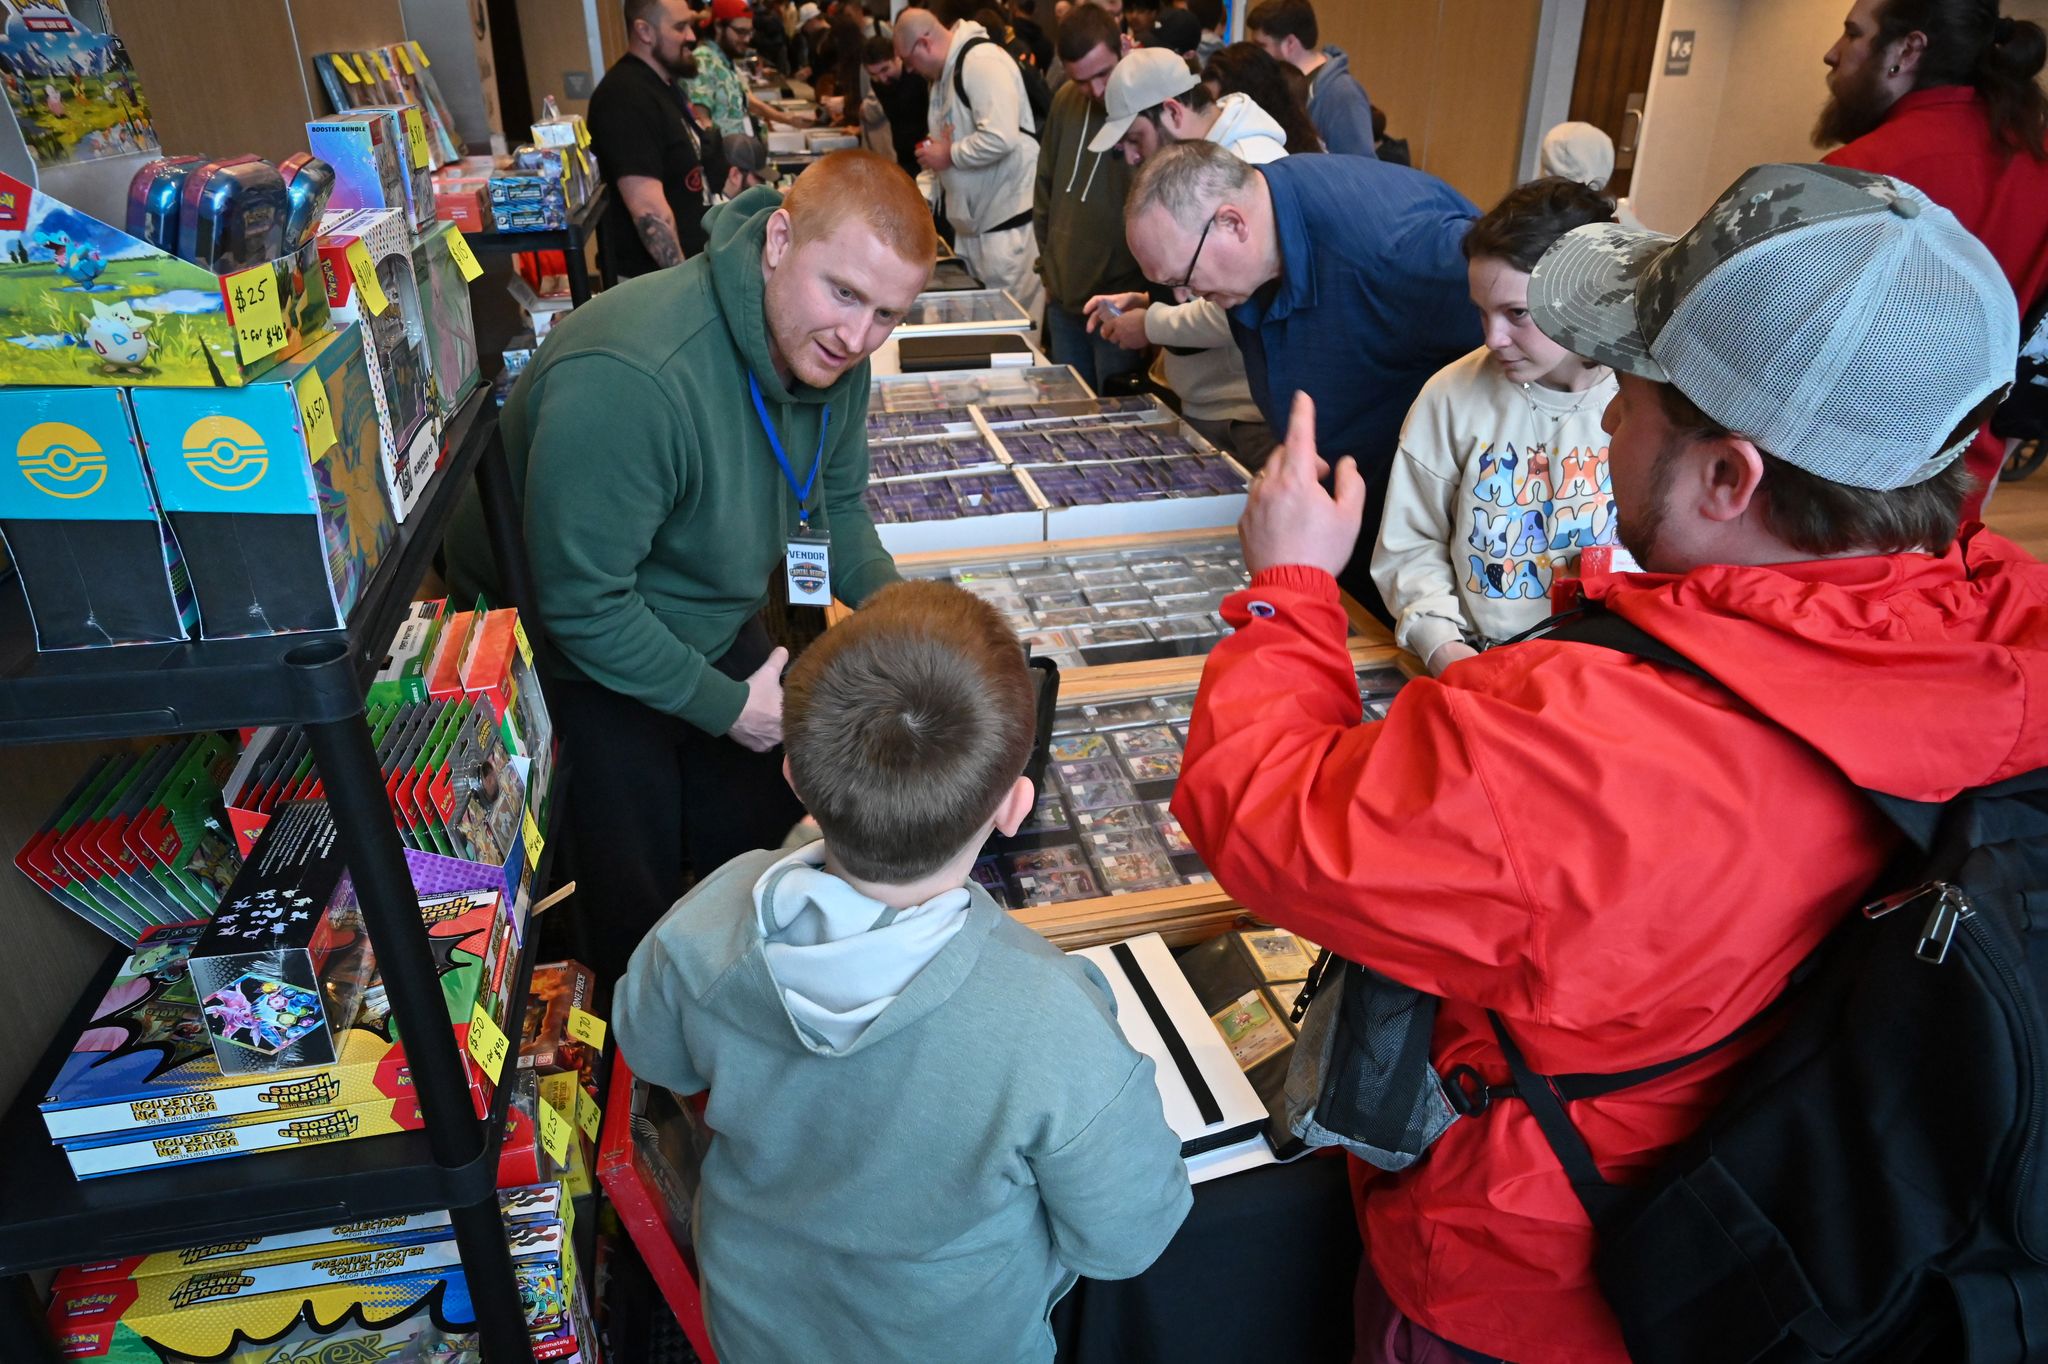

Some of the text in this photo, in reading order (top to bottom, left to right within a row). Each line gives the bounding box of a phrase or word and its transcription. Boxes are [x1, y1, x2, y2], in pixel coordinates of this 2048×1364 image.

[235, 278, 267, 313] $25
[241, 329, 248, 341] 2
[266, 324, 283, 348] $40
[305, 396, 325, 433] $150
[788, 550, 825, 561] VENDOR
[421, 896, 469, 914] HERO
[421, 901, 476, 919] ASCEN
[572, 972, 587, 1009] ONE PIECE
[469, 1016, 485, 1052] $50
[258, 1080, 340, 1104] ASCENDED
[268, 1073, 333, 1097] HEROES
[130, 1093, 214, 1112] COLLECTION
[133, 1101, 218, 1122] DELUXE PIN
[145, 1112, 211, 1126] FIRST PARTNERS
[278, 1115, 359, 1138] ASCENDED
[288, 1109, 351, 1132] HEROES
[543, 1110, 558, 1151] $125
[152, 1130, 236, 1150] COLLECTION
[155, 1137, 239, 1158] DELUXE PIN
[331, 1216, 408, 1235] COLLECTION
[341, 1226, 393, 1239] MEGA LUCARIO
[182, 1241, 249, 1266] HEROES
[311, 1246, 425, 1271] PREMIUM POSTER
[327, 1257, 405, 1276] COLLECTION
[337, 1267, 391, 1281] MEGA LUCARIO
[168, 1275, 256, 1300] ASCENDED
[173, 1284, 241, 1309] HEROES
[319, 1333, 389, 1363] ex
